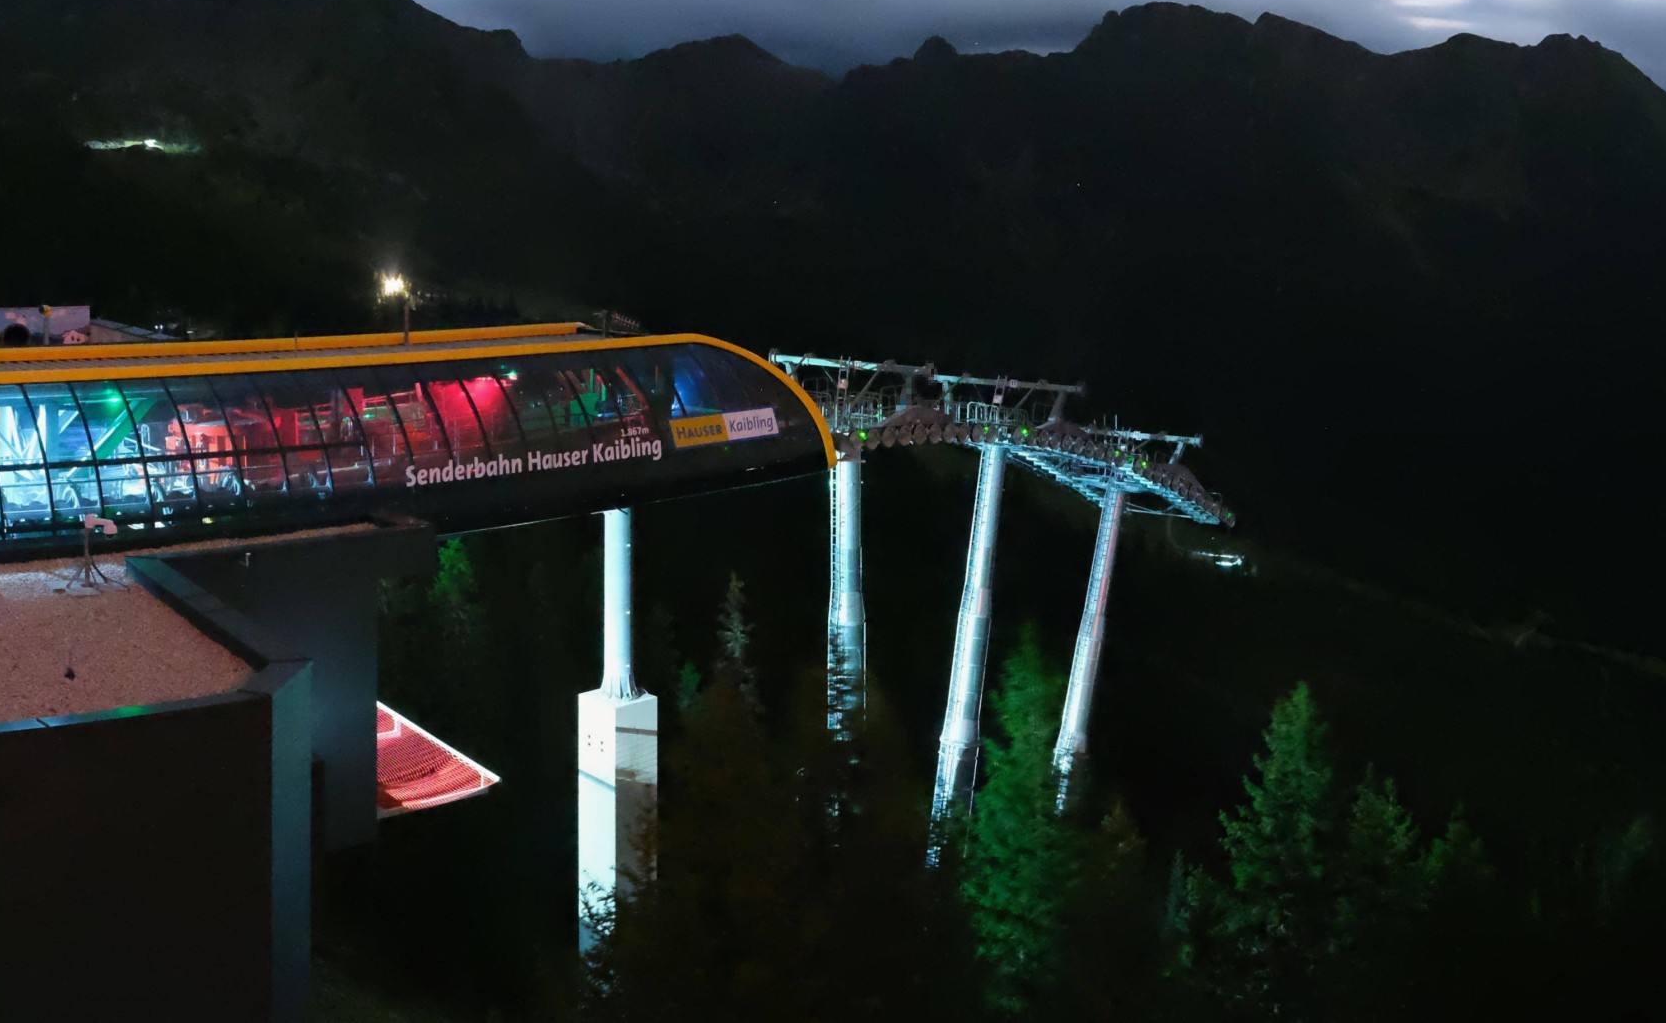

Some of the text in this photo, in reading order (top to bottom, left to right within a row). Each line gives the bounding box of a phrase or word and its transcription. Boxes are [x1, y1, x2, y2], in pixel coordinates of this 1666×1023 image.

[676, 414, 774, 440] HAUSER Kaibling
[405, 437, 662, 487] Senderbahn Hauser Kaibling
